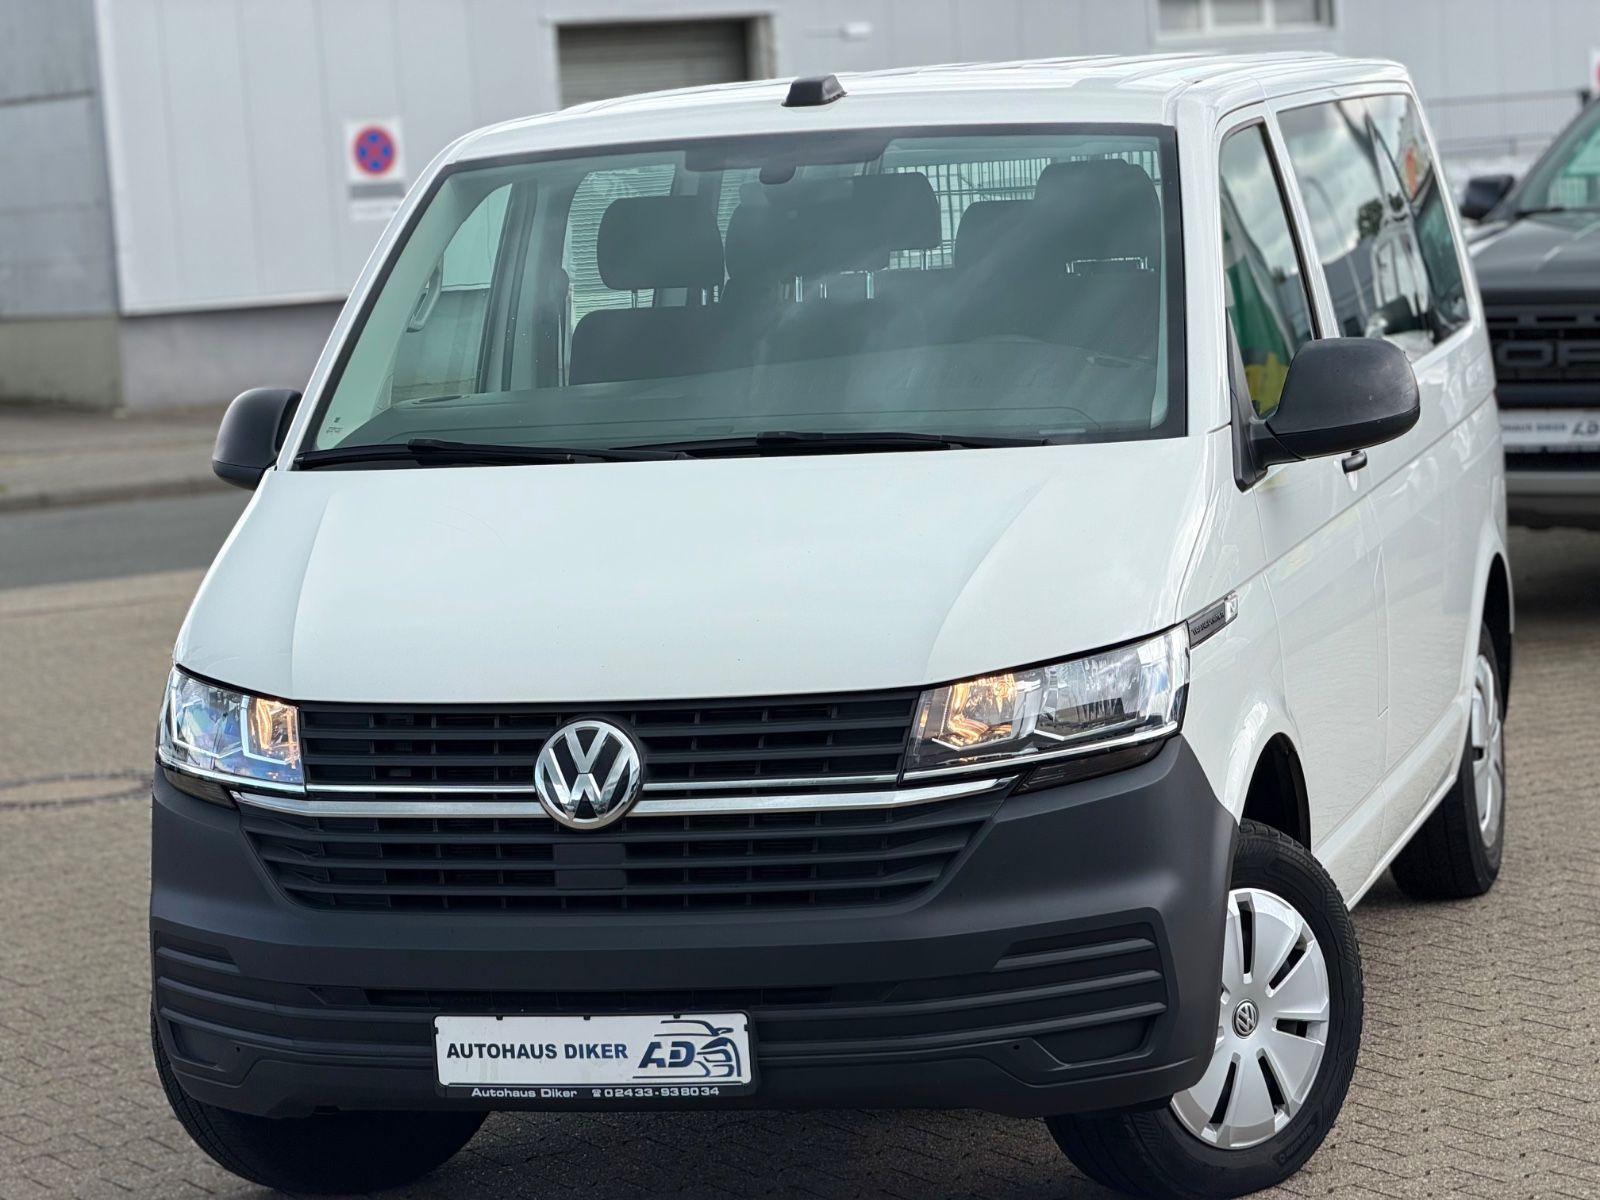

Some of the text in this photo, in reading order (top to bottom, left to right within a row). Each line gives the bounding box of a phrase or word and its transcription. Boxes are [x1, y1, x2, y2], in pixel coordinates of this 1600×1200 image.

[447, 1043, 628, 1059] AUTOHAUS DIKER
[471, 1086, 720, 1098] Autohaus Diker 02433-938034
